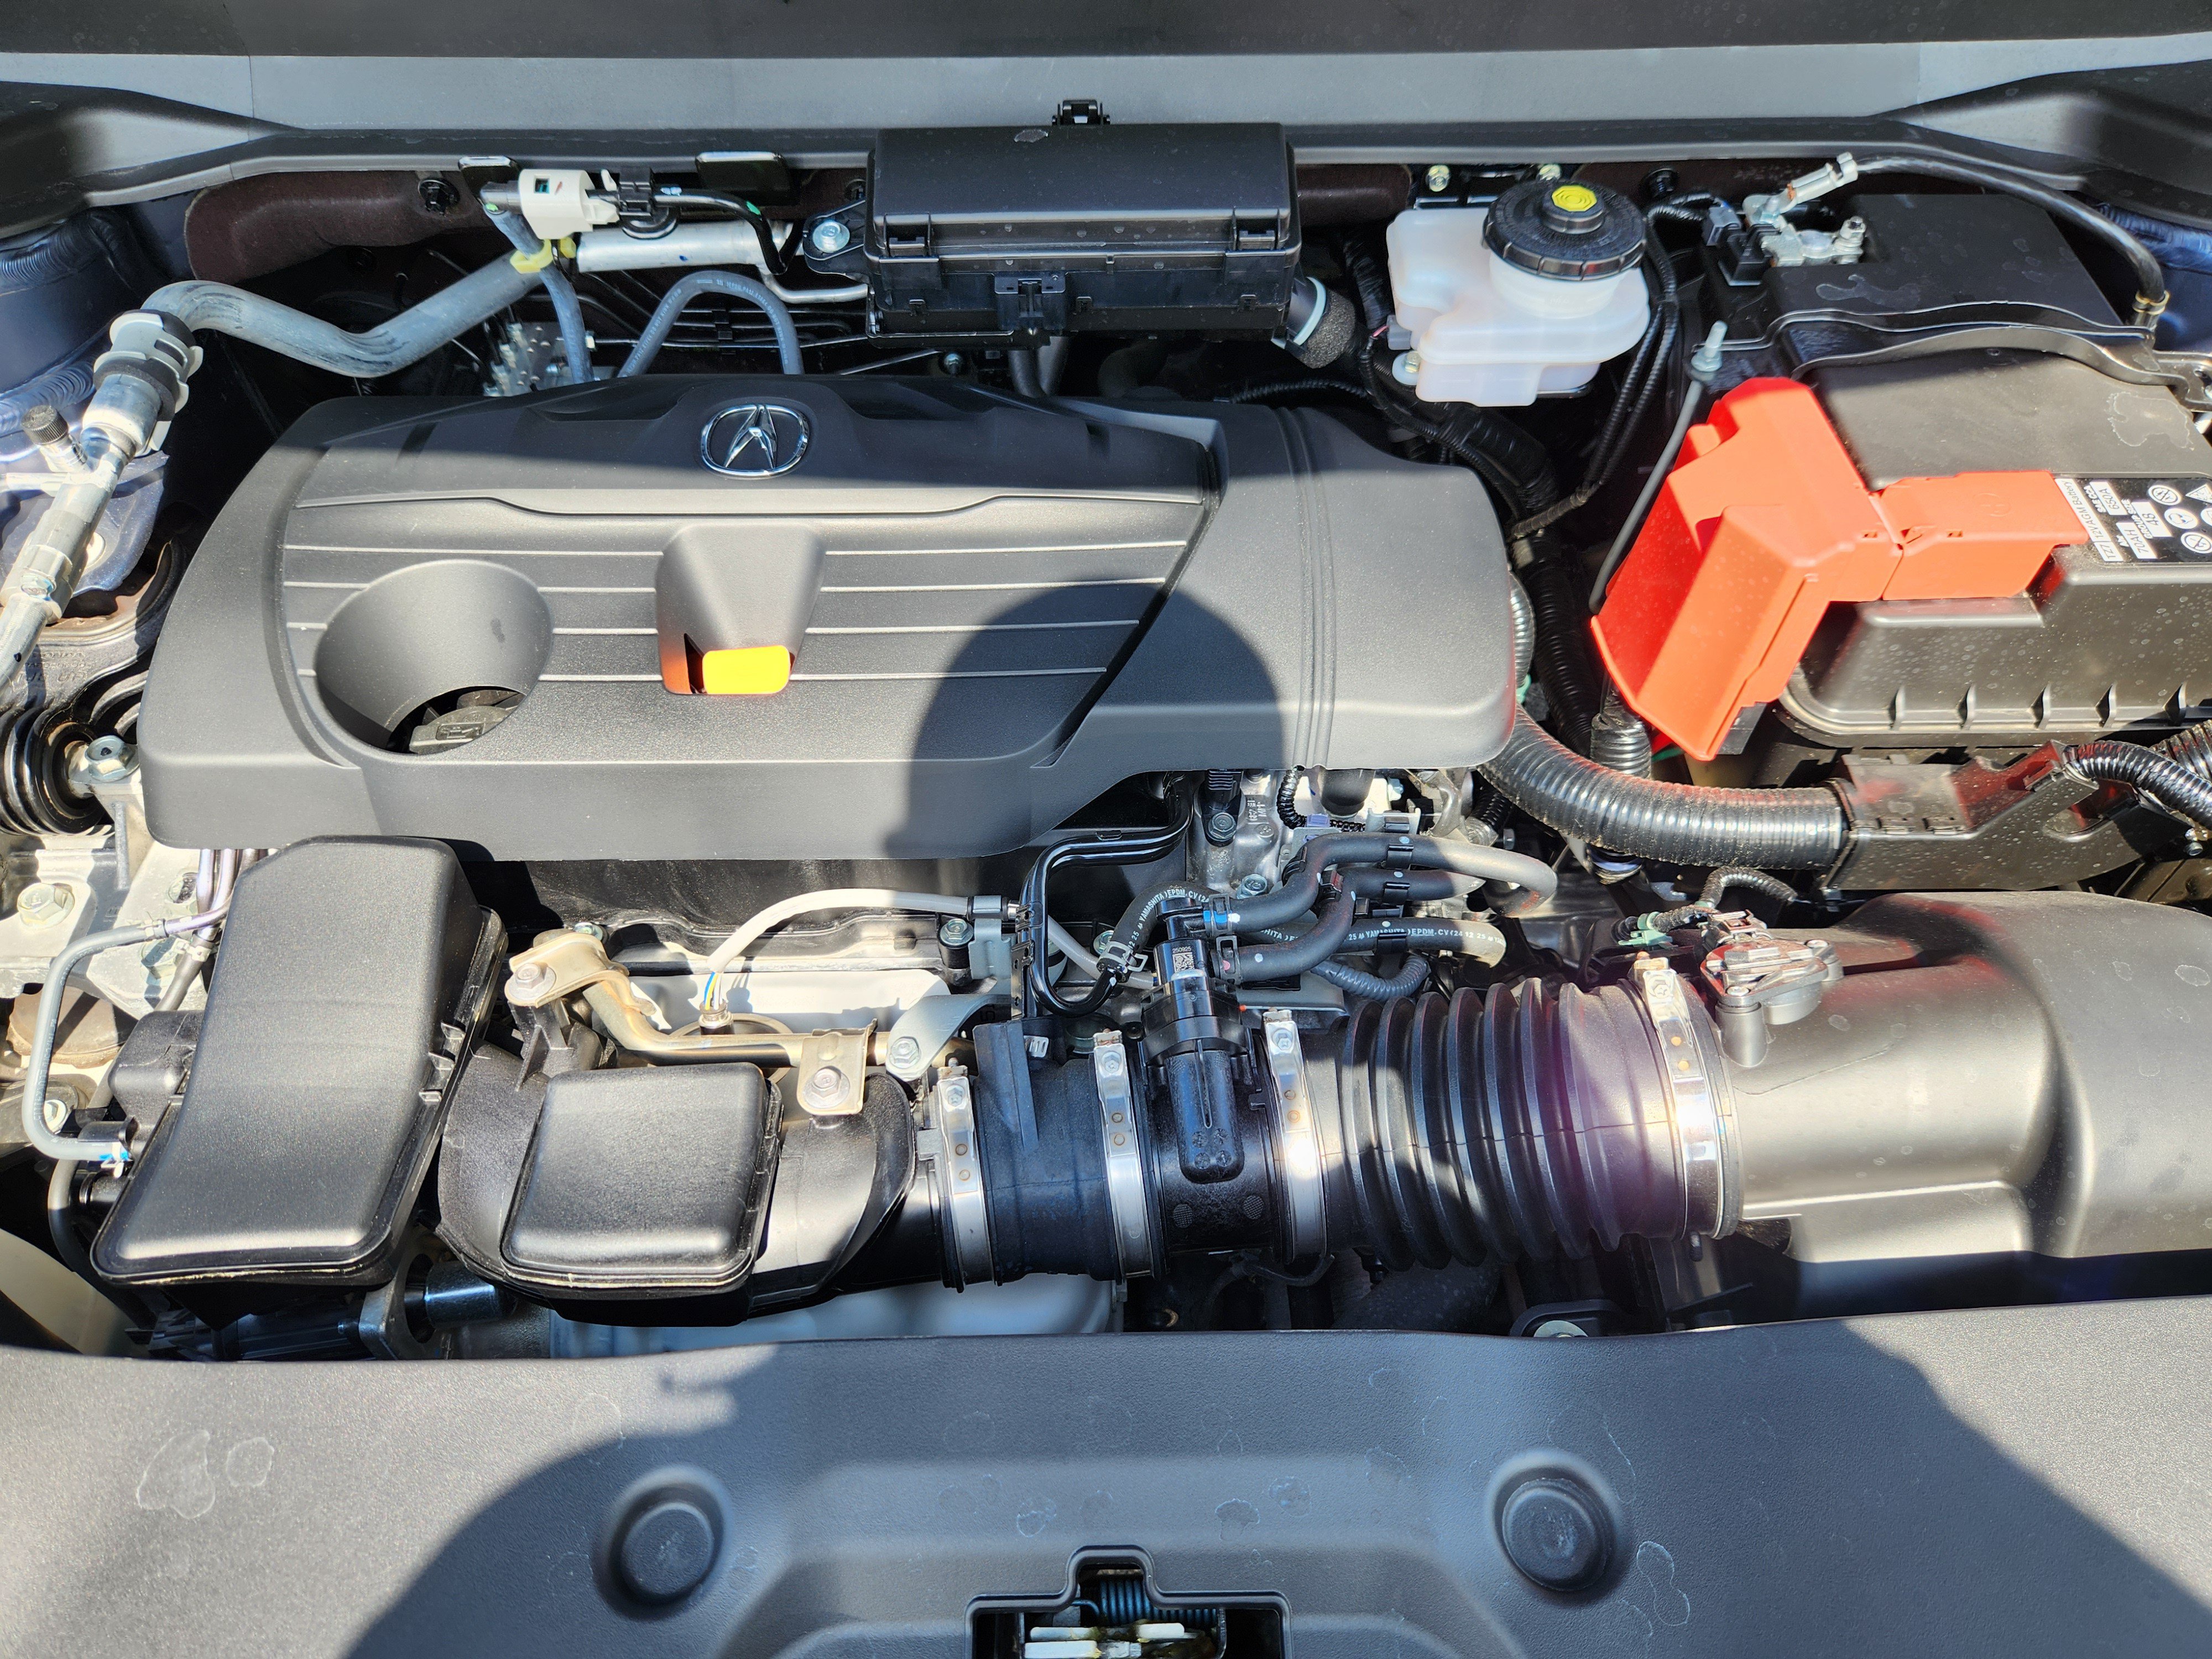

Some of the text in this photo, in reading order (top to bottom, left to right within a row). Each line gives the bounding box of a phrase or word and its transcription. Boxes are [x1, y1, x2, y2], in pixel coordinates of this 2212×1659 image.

[2061, 480, 2083, 506] Battery
[2083, 485, 2107, 513] SAE CCA
[2099, 488, 2120, 510] 650A
[2077, 504, 2097, 525] AGM
[2131, 514, 2153, 539] GROUP
[2142, 513, 2159, 526] 48
[2088, 525, 2105, 539] 12V
[2124, 529, 2149, 554] 70AH
[1139, 891, 1165, 922] YAMASHITA
